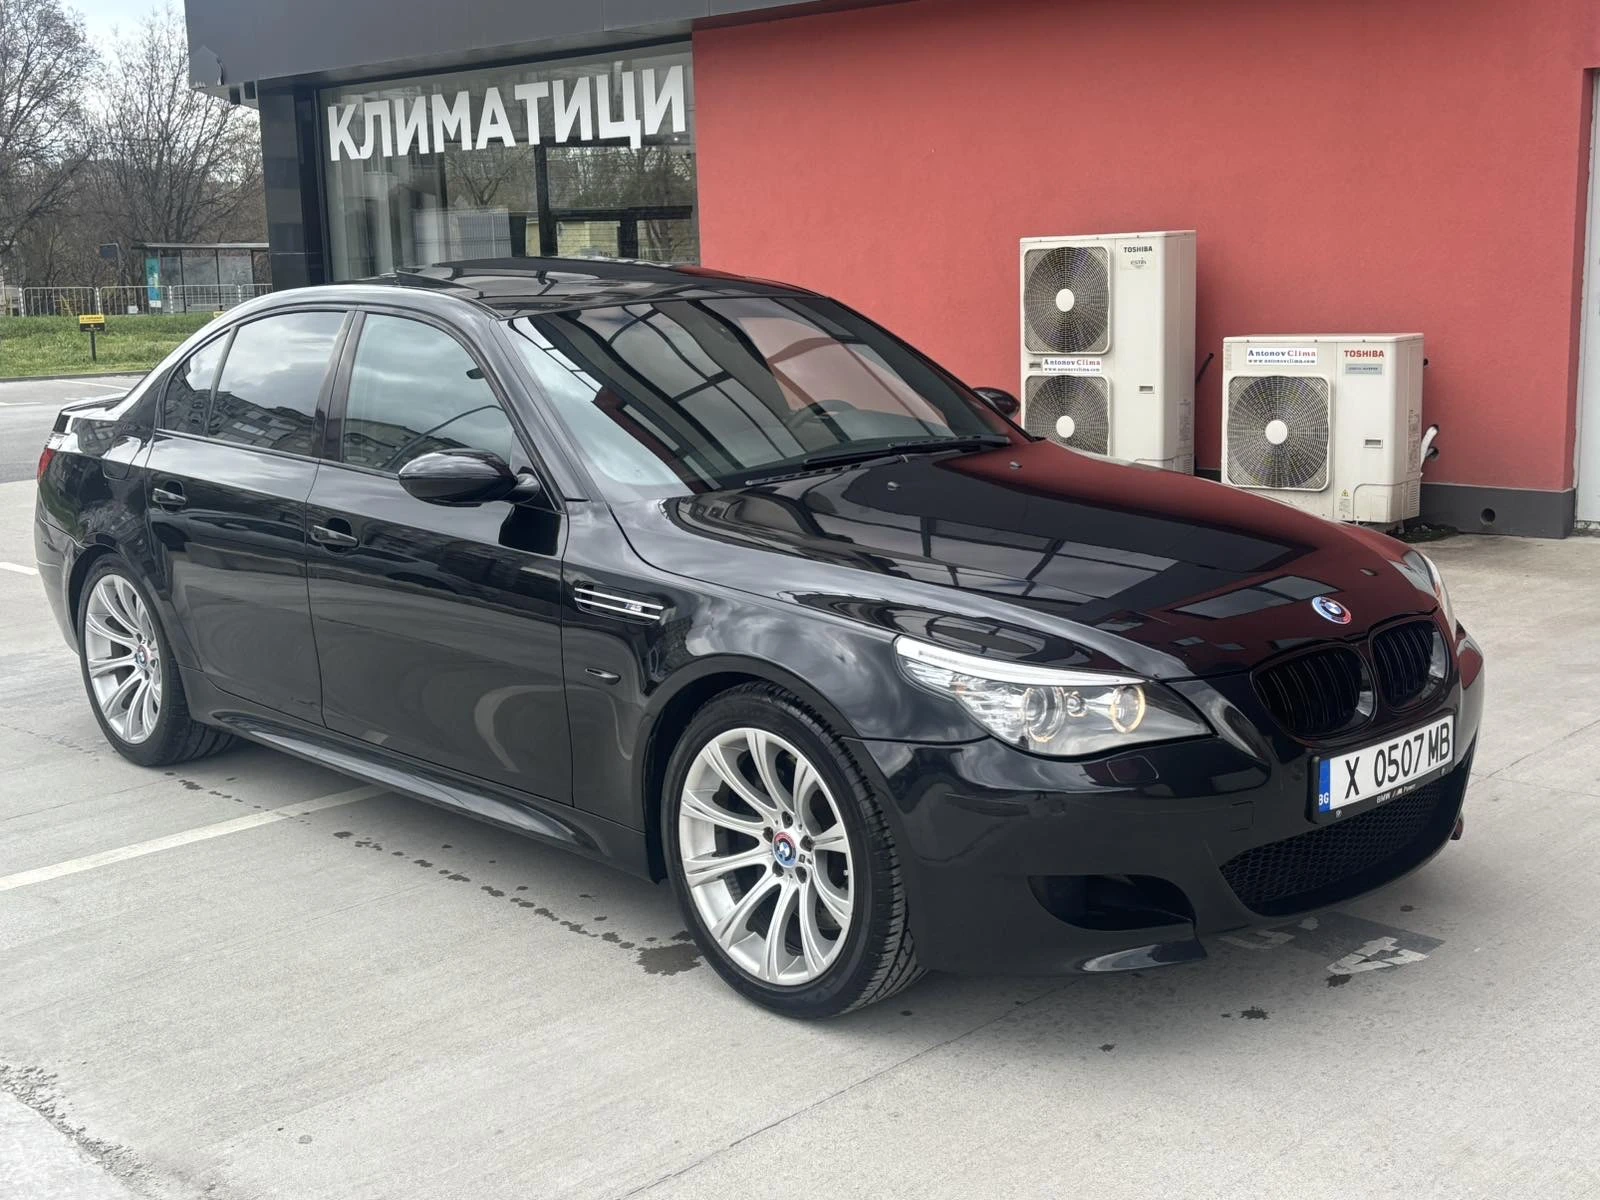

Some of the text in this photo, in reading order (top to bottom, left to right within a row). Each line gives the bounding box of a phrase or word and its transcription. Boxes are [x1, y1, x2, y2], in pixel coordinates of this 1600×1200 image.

[328, 65, 686, 161] КЛИМАТИЦИ
[1344, 350, 1384, 358] TOSHIBA
[1344, 723, 1450, 800] X 0507 MB
[1318, 793, 1329, 806] BG
